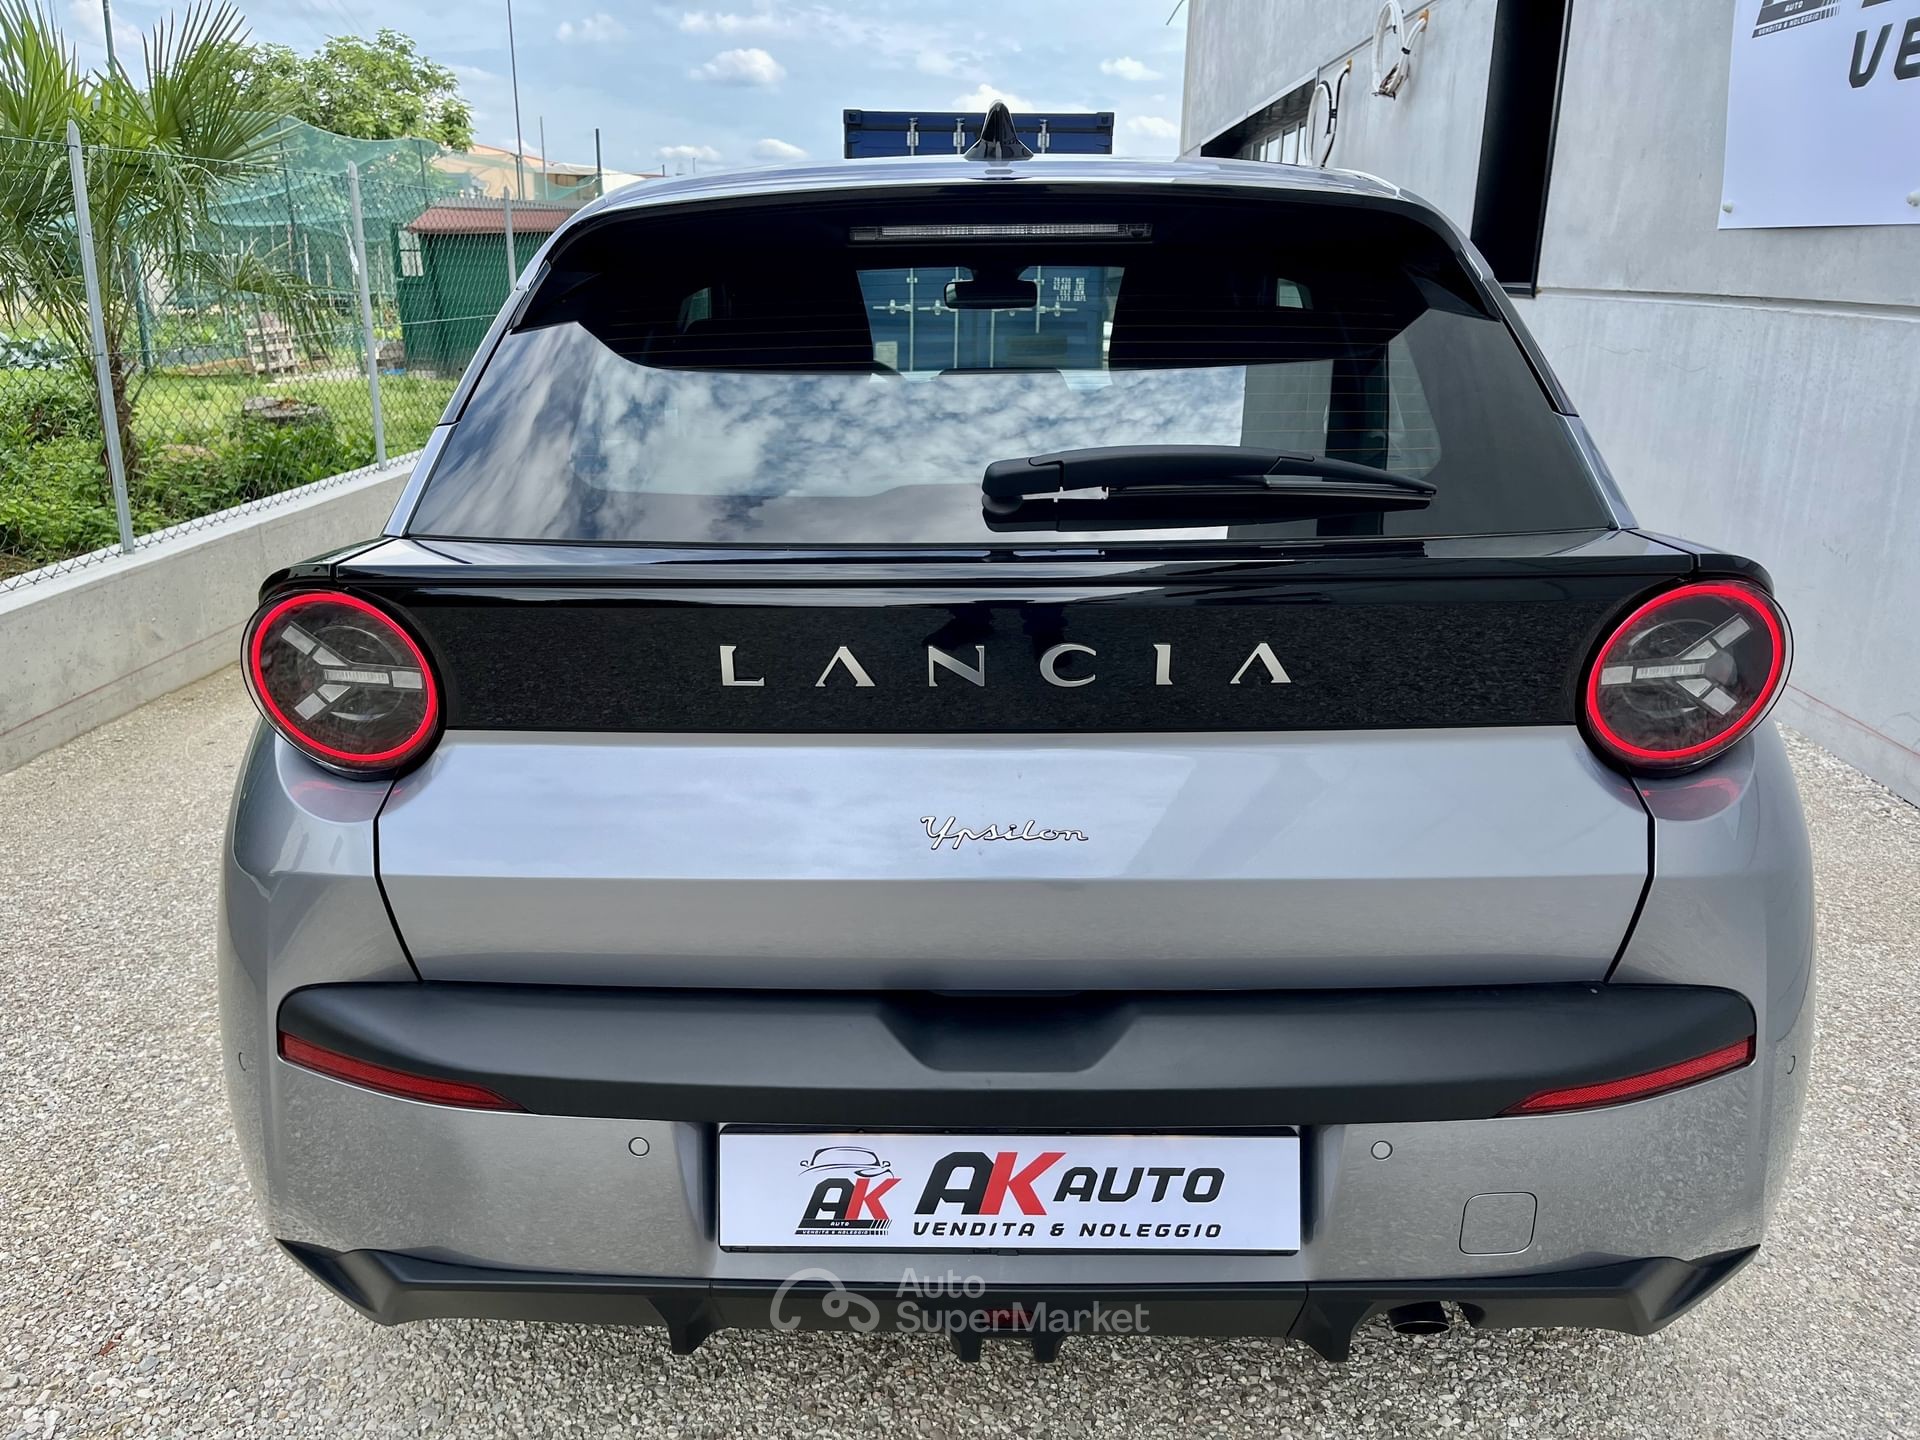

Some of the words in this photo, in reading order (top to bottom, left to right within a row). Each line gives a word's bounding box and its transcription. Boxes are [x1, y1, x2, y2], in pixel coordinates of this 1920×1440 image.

[1784, 1, 1804, 13] AUTO
[719, 642, 1292, 687] LANCIA
[920, 816, 1089, 850] Ypsilon
[803, 1178, 902, 1220] AK
[913, 1151, 1067, 1216] AK
[1053, 1166, 1225, 1203] AUTO
[912, 1221, 1036, 1237] VENDITA
[1049, 1222, 1065, 1237] &
[1079, 1223, 1222, 1238] NOLEGGIO
